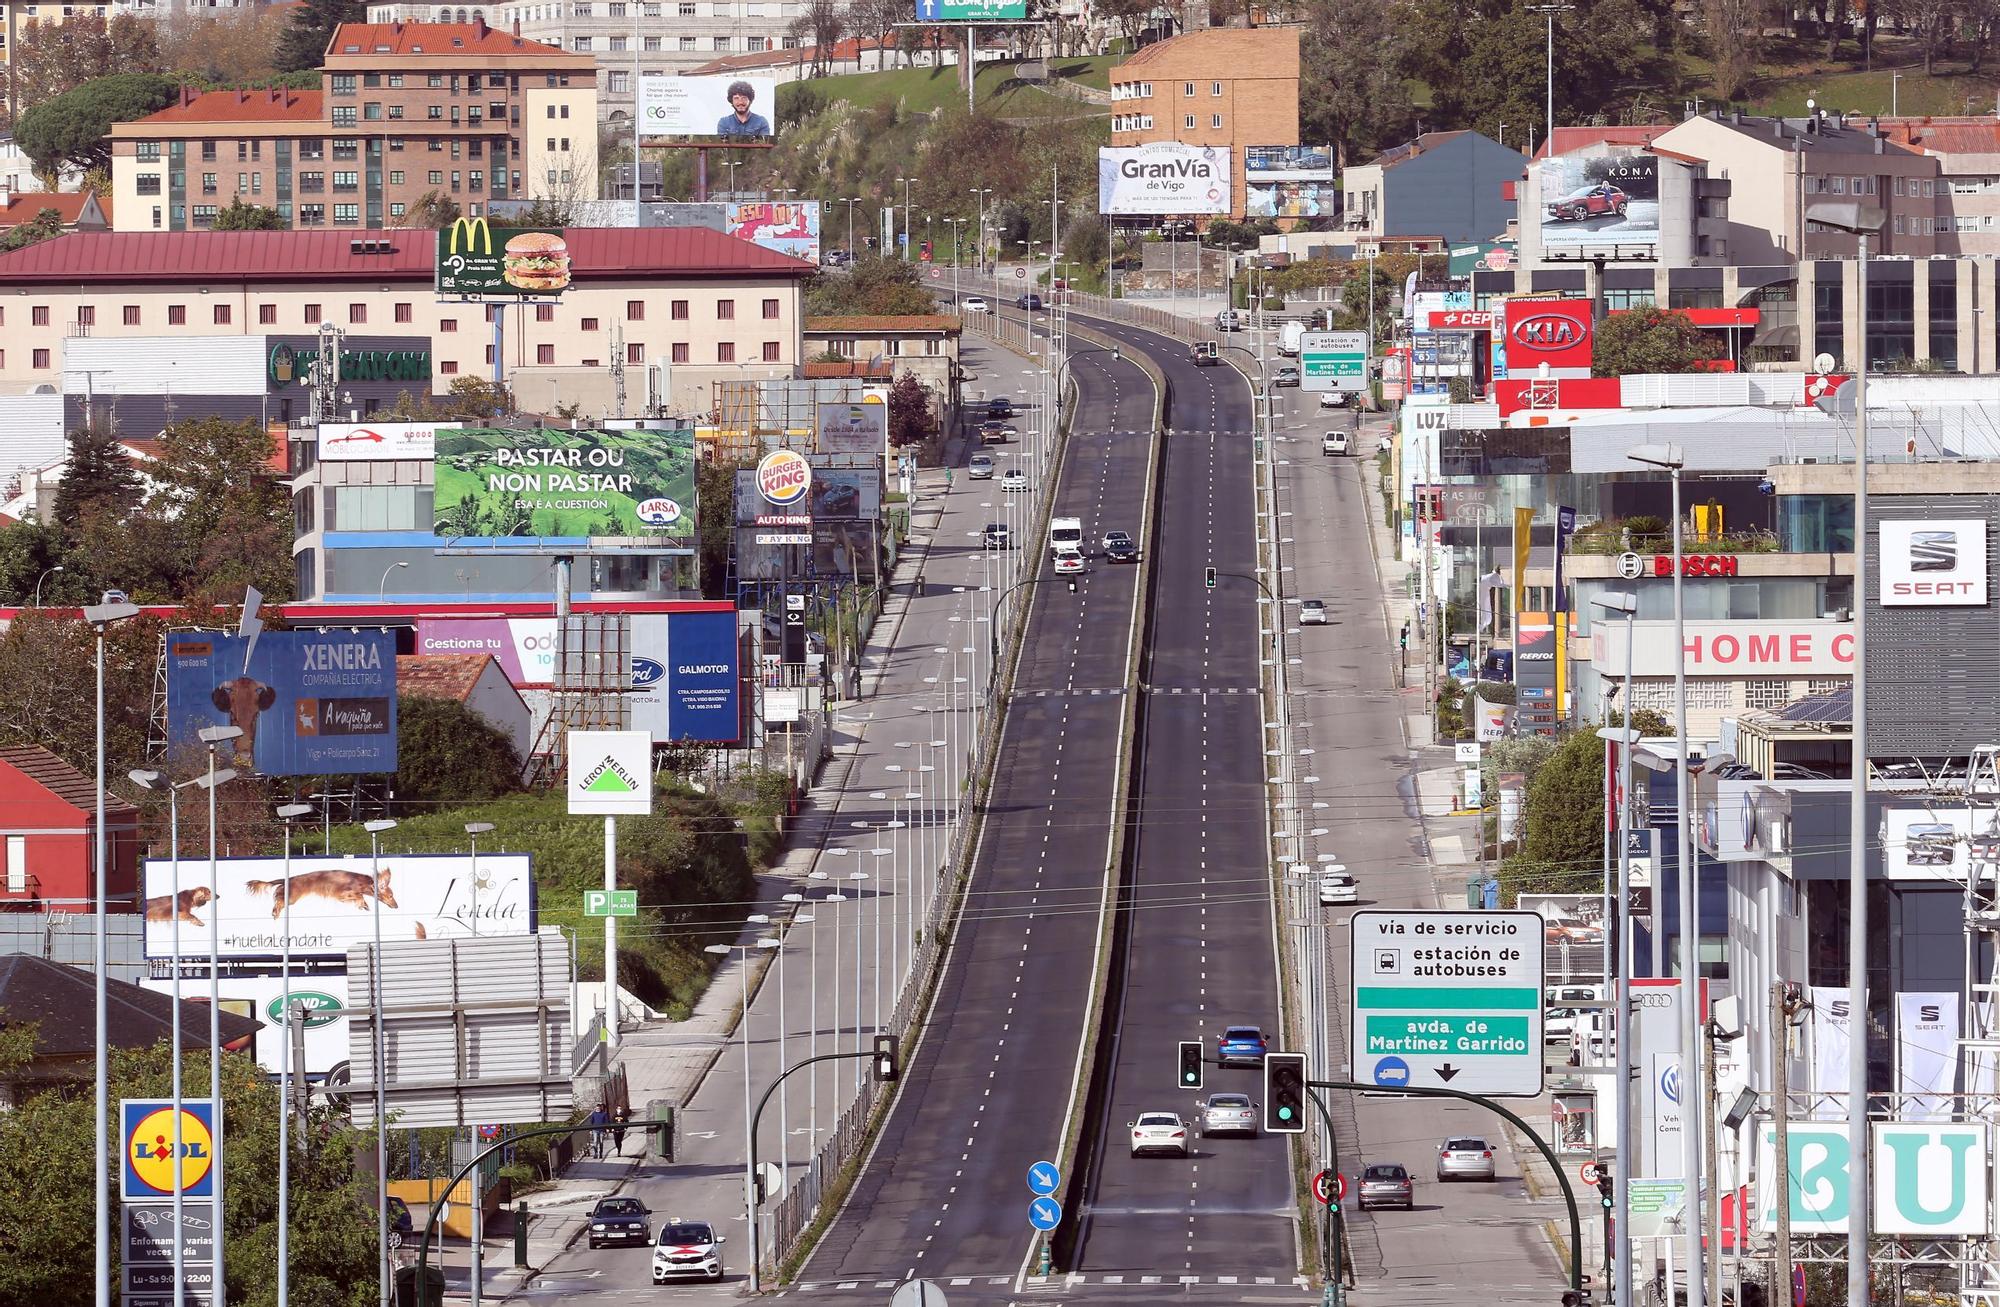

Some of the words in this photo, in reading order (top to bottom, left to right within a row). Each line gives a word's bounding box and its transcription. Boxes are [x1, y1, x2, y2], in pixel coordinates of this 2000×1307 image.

[1608, 167, 1653, 176] KONA
[1146, 180, 1160, 190] de
[1161, 180, 1185, 192] Vigo
[1460, 313, 1491, 325] CEP
[1525, 321, 1575, 343] KIA
[497, 448, 582, 467] PASTAR
[588, 448, 625, 467] OU
[762, 460, 803, 480] BURGER
[489, 474, 541, 492] NON
[548, 474, 633, 492] PASTAR
[763, 470, 805, 494] KING
[514, 500, 533, 509] ESA
[546, 500, 553, 509] A
[555, 498, 609, 509] CUESTIÓN
[641, 502, 677, 515] LARSA
[1893, 582, 1974, 595] SEAT
[424, 638, 484, 650] Gestiona
[487, 639, 501, 649] tu
[1682, 633, 1812, 663] HOME
[303, 642, 382, 671] XENERA
[1519, 652, 1554, 660] REPSOL
[678, 664, 729, 675] GALMOTOR
[579, 762, 607, 791] LEROY
[603, 754, 640, 791] MERLIN
[435, 876, 519, 936] Lenda
[590, 893, 606, 913] P
[1378, 919, 1405, 935] vía
[1414, 921, 1436, 935] de
[1444, 919, 1518, 935] servicio
[1413, 945, 1491, 961] estación
[1499, 948, 1520, 961] de
[1413, 963, 1507, 976] autobuses
[1407, 1020, 1454, 1034] avda.
[1465, 1020, 1489, 1034] de
[1456, 1035, 1526, 1051] Garrido
[1663, 1114, 1679, 1122] Veh
[1584, 1169, 1597, 1178] 50
[130, 1236, 175, 1246] Enfornam
[186, 1236, 213, 1245] varias
[146, 1248, 172, 1256] veces
[182, 1246, 197, 1256] día
[133, 1275, 144, 1283] Lu
[148, 1275, 159, 1283] Sa
[160, 1274, 174, 1283] 9:0
[186, 1273, 211, 1283] 22:00
